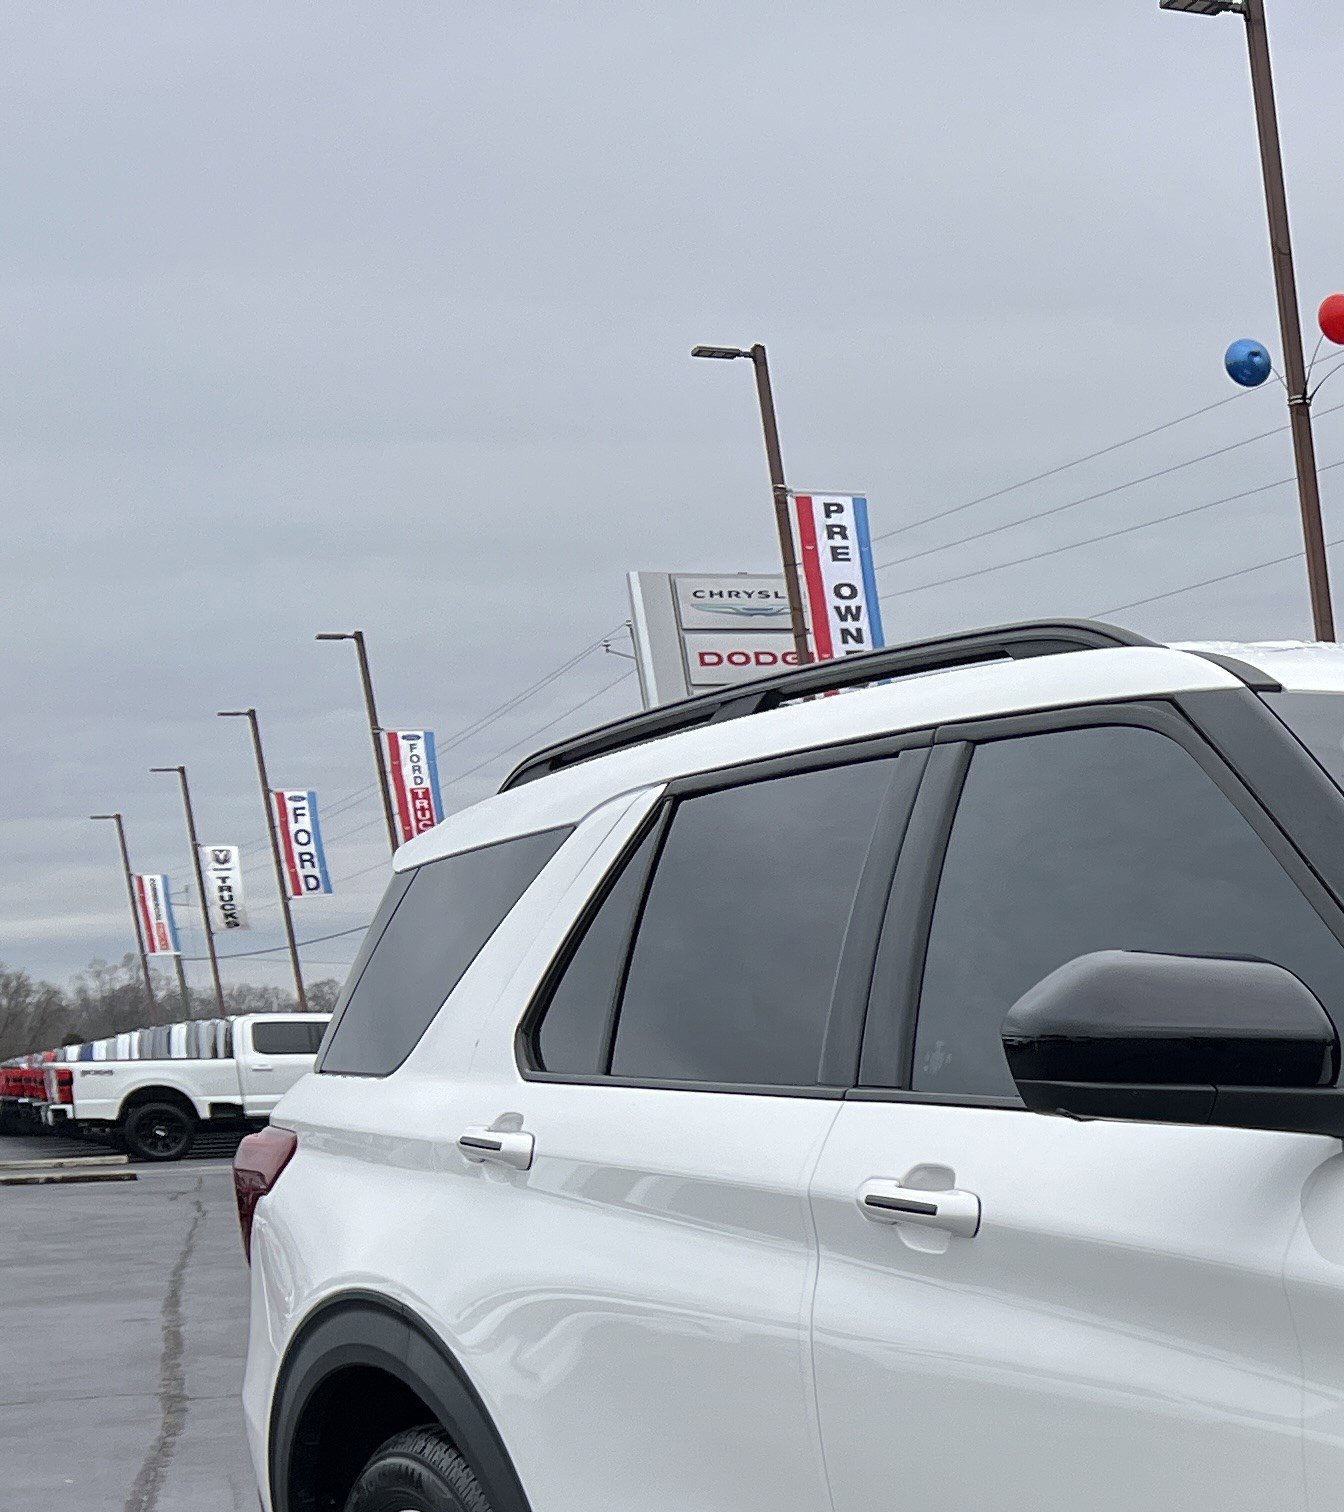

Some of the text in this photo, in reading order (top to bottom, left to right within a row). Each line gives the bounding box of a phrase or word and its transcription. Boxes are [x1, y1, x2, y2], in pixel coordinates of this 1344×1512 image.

[692, 589, 787, 600] CHRYSL
[822, 501, 865, 656] PRE OWN
[697, 651, 816, 667] DODG
[408, 743, 425, 786] FORD
[412, 788, 433, 832] TRUC
[292, 805, 321, 892] FORD
[215, 875, 241, 929] TRUCKS
